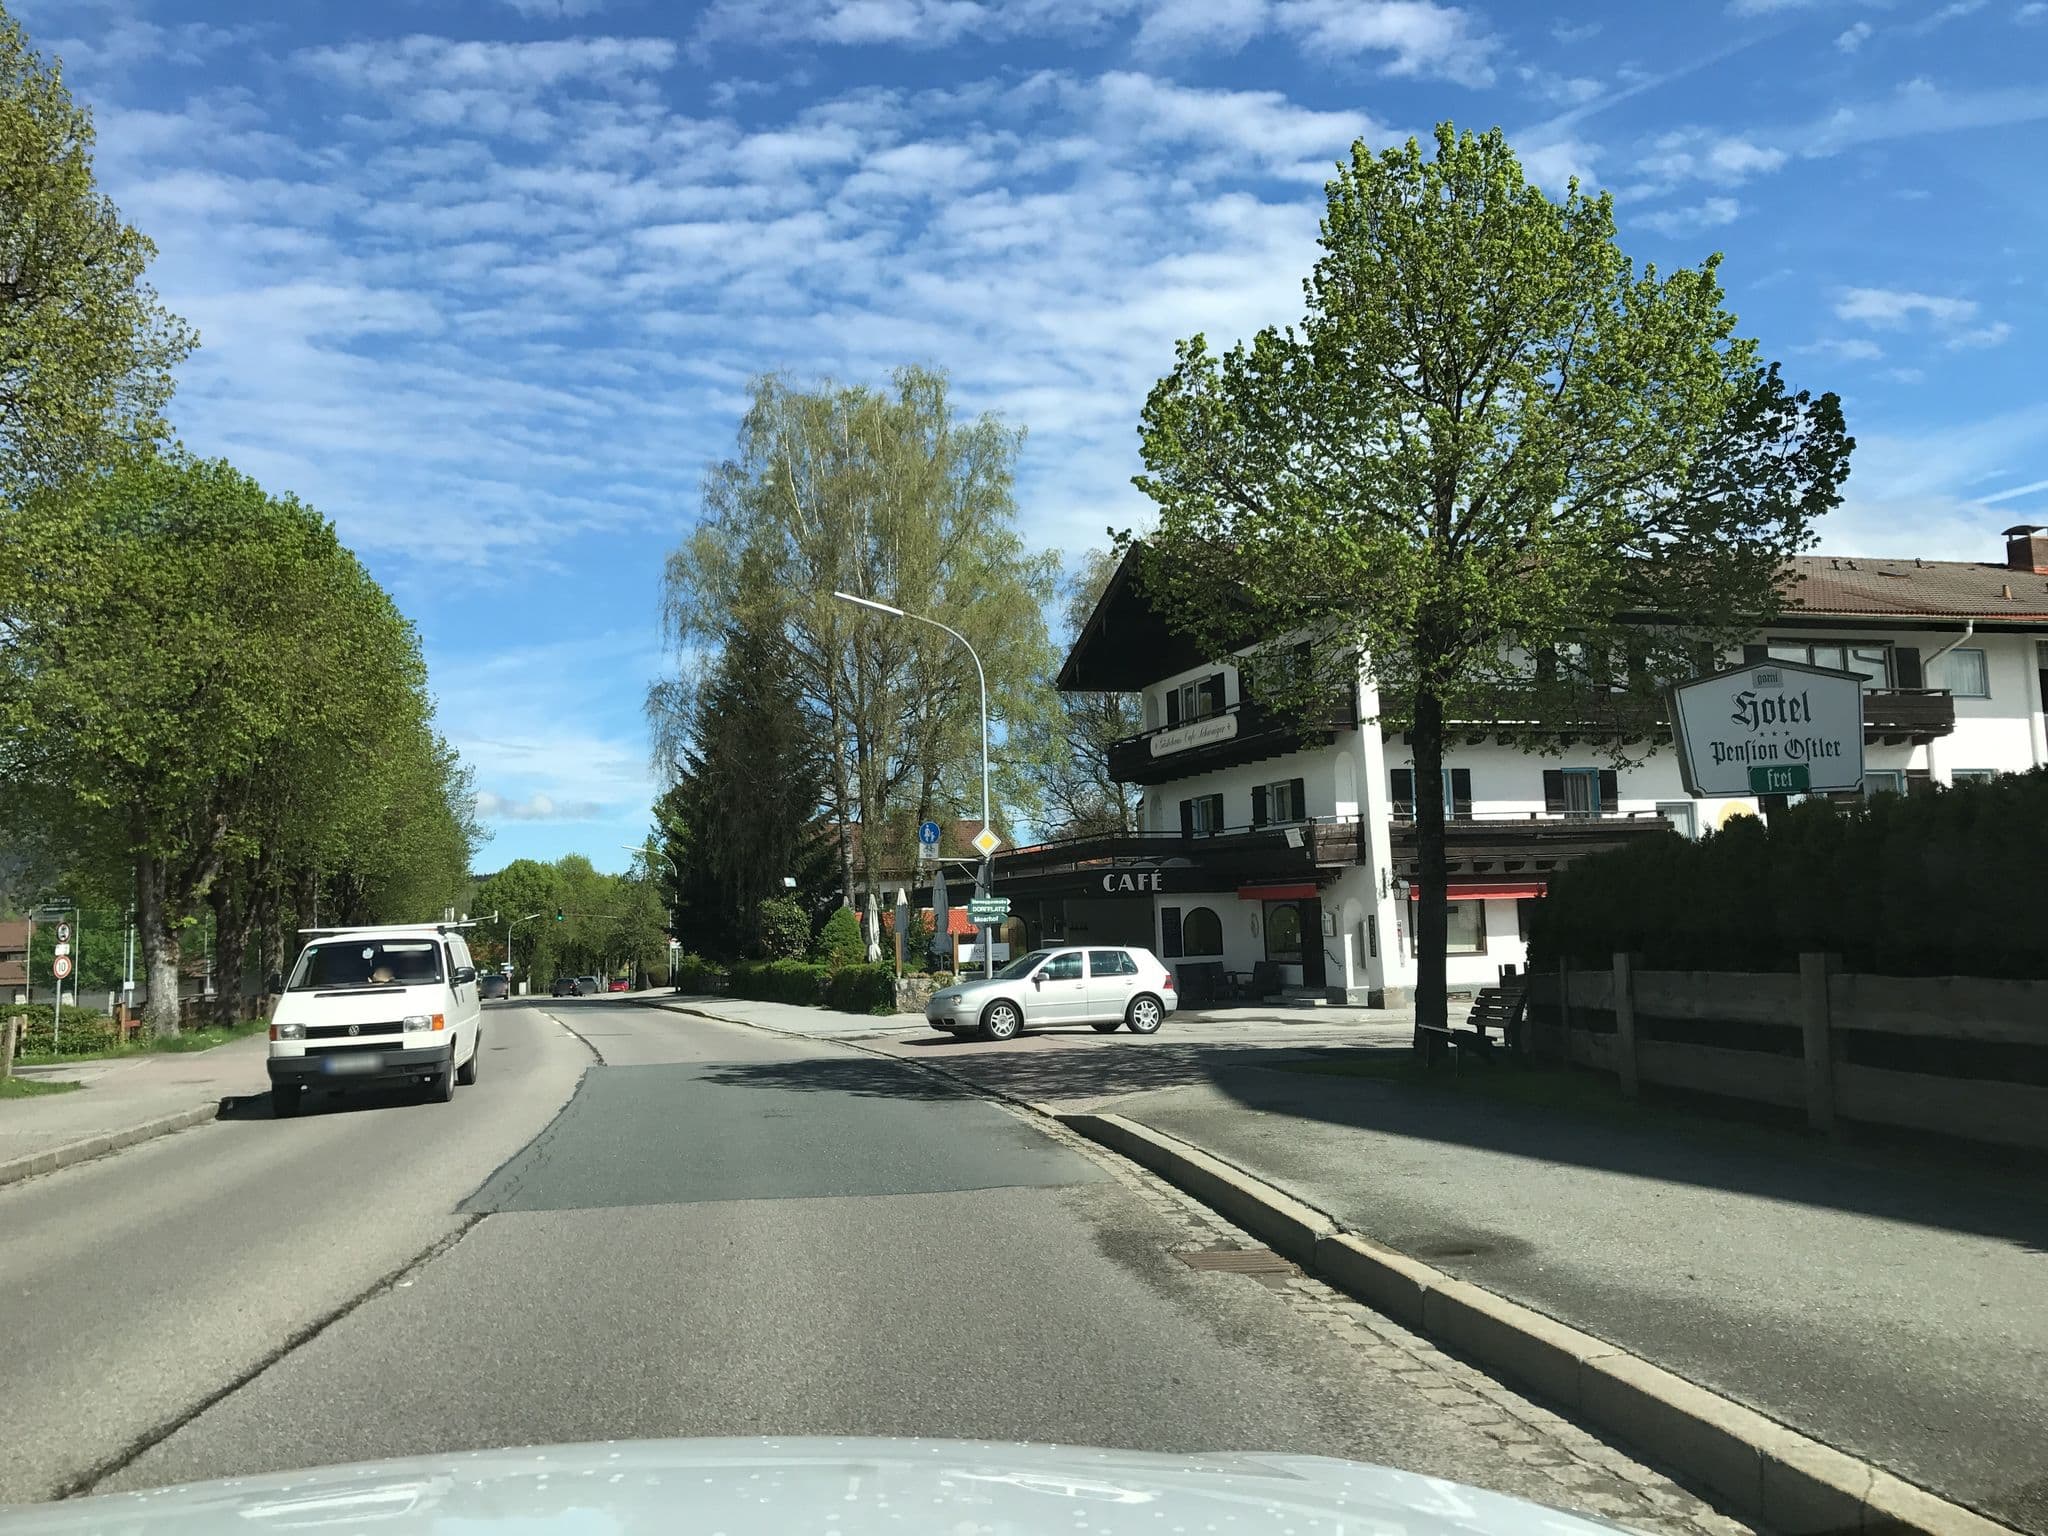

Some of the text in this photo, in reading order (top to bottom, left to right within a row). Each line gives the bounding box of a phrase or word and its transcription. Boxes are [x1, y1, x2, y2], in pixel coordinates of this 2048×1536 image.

[1757, 674, 1778, 686] garni
[1731, 688, 1812, 732] Hotel
[1767, 767, 1792, 791] frei
[1102, 868, 1163, 892] CAFÉ
